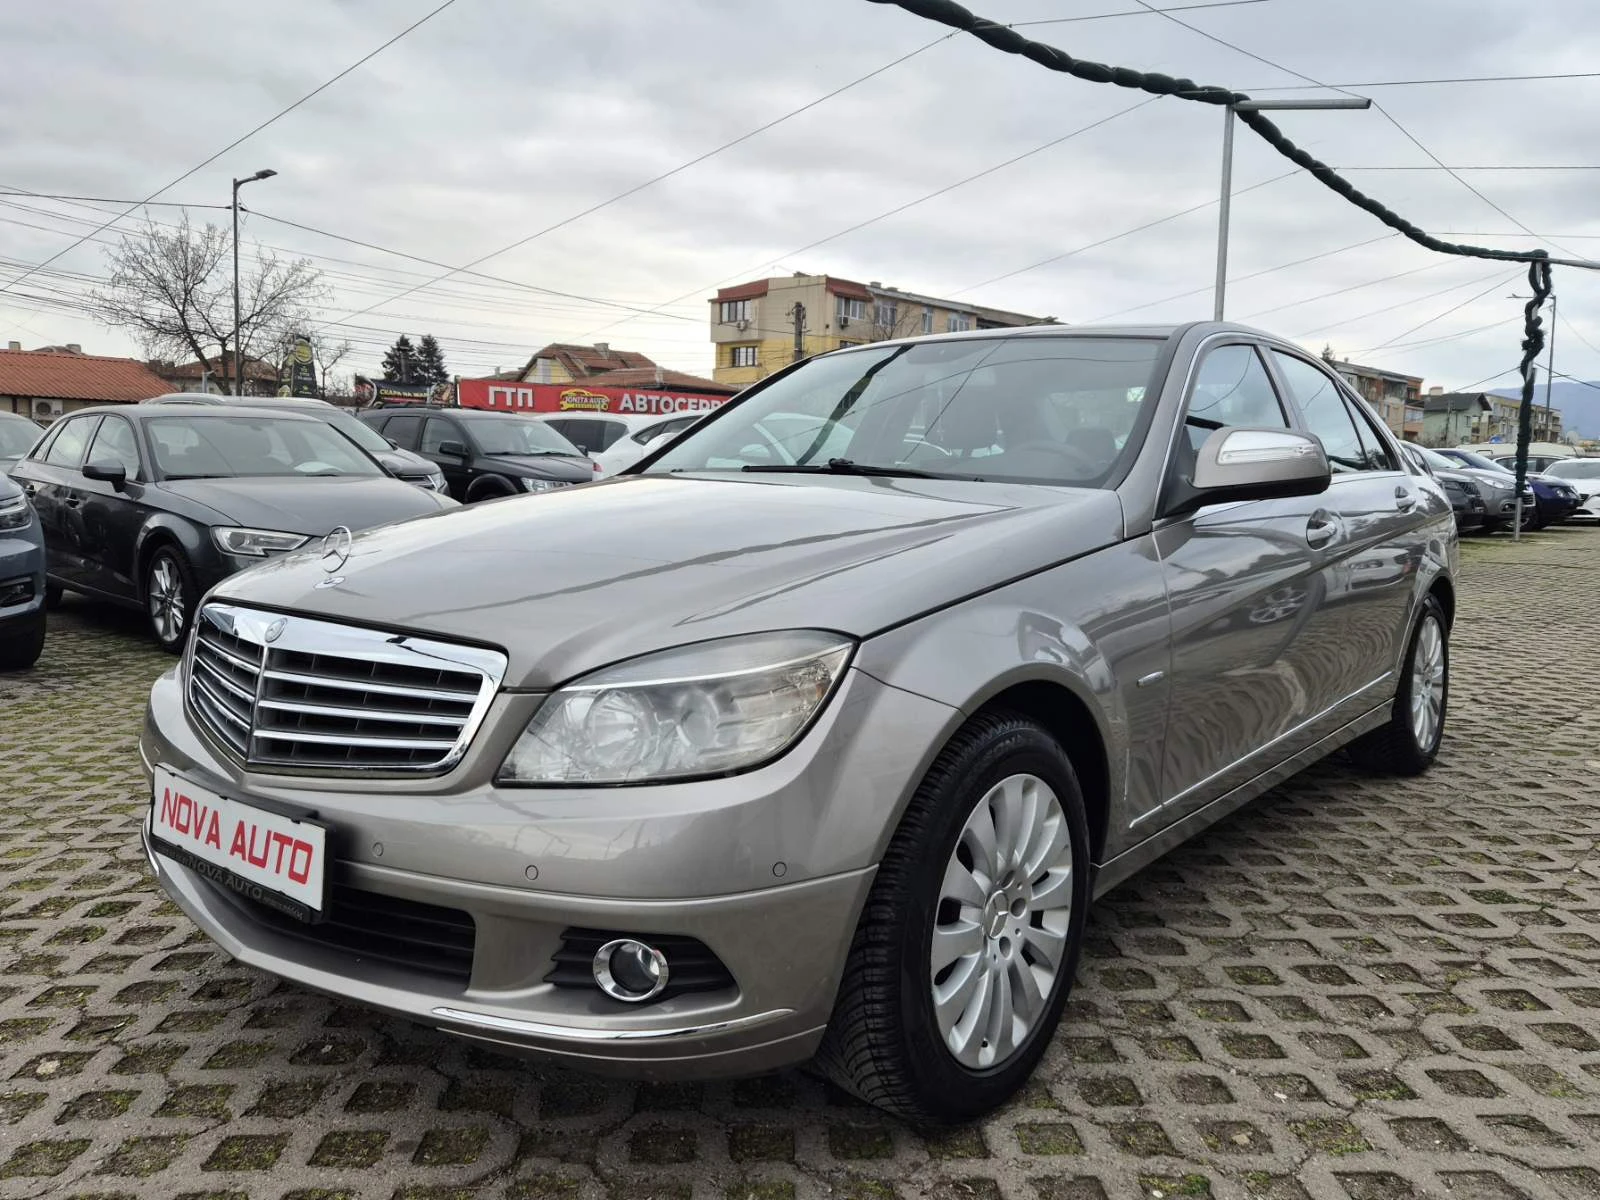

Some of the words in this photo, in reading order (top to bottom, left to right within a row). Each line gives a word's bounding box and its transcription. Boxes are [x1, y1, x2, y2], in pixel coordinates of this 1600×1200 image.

[488, 385, 534, 408] ГТП
[619, 393, 726, 414] АВТОСЕРВ
[160, 787, 221, 850] NOVA
[229, 819, 314, 886] AUTO
[188, 855, 223, 882] NOVA
[224, 874, 263, 899] AUTO
